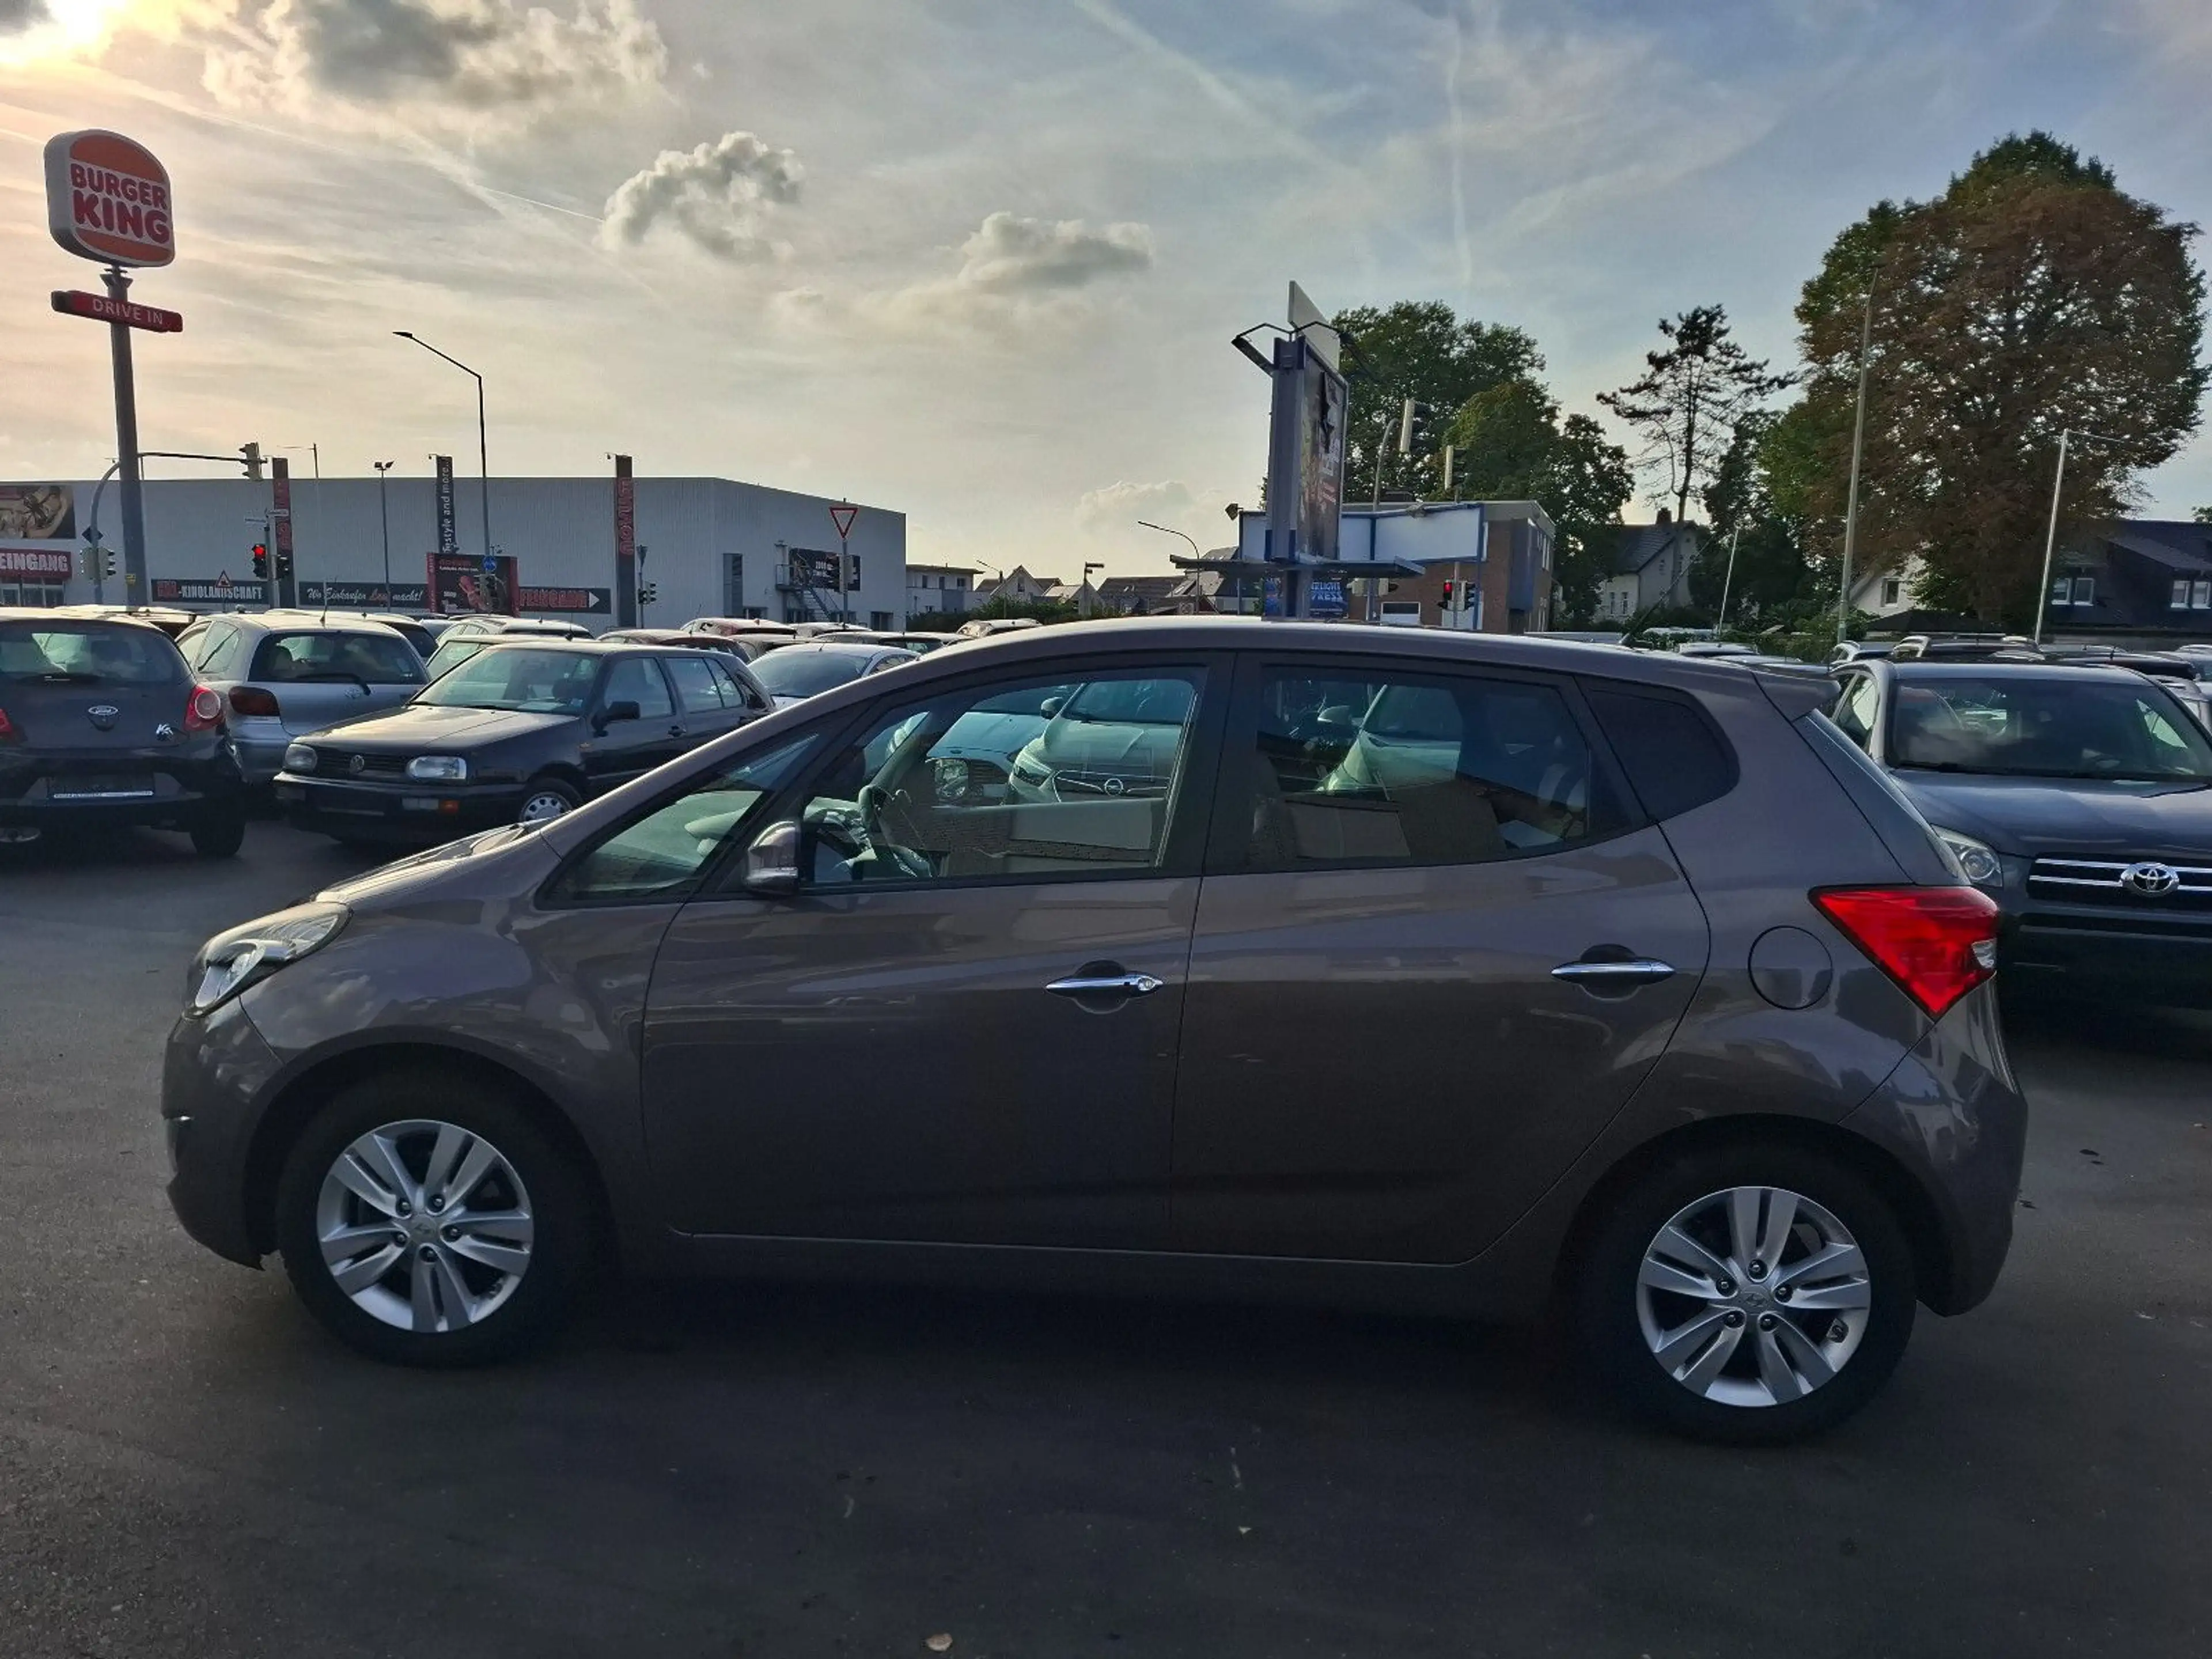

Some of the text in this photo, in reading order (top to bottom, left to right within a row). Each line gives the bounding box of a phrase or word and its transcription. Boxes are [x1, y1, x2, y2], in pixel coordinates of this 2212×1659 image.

[70, 163, 168, 210] BURGER
[72, 190, 169, 244] KING
[92, 298, 163, 325] DRIVE IN
[0, 552, 69, 571] EINGANG
